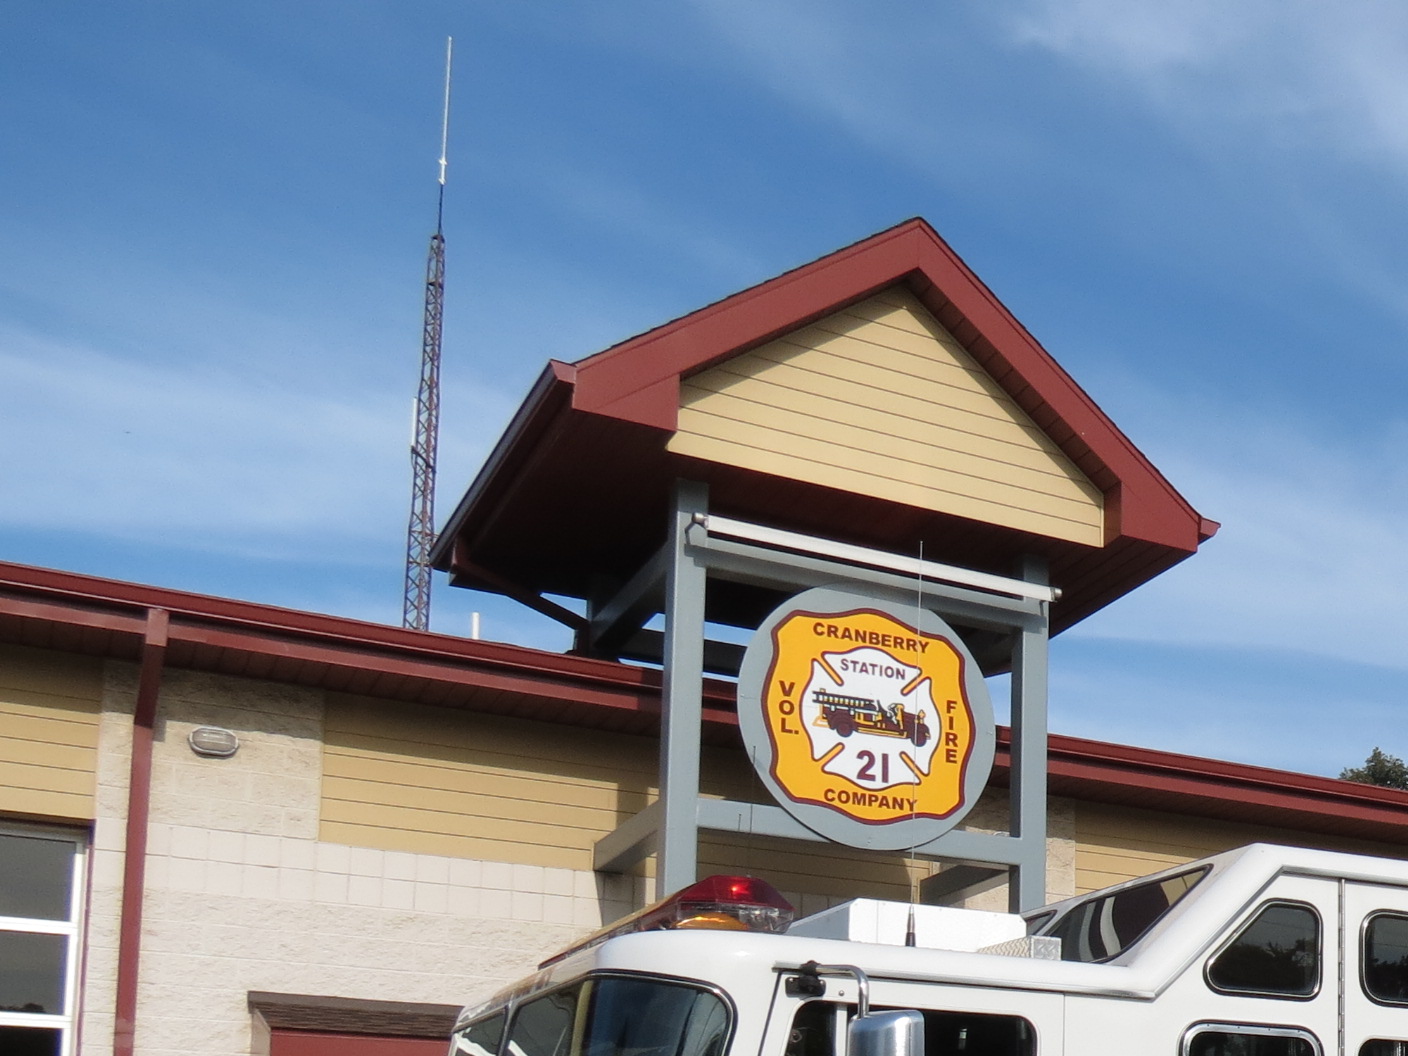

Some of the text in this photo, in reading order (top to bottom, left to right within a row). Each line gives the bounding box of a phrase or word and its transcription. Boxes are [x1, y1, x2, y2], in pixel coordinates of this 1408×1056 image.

[812, 621, 930, 654] CRANBERRY
[840, 658, 907, 681] STATION
[778, 680, 800, 735] VOL.
[945, 699, 959, 764] FIRE
[856, 750, 890, 784] 21
[823, 788, 918, 812] COMPANY
